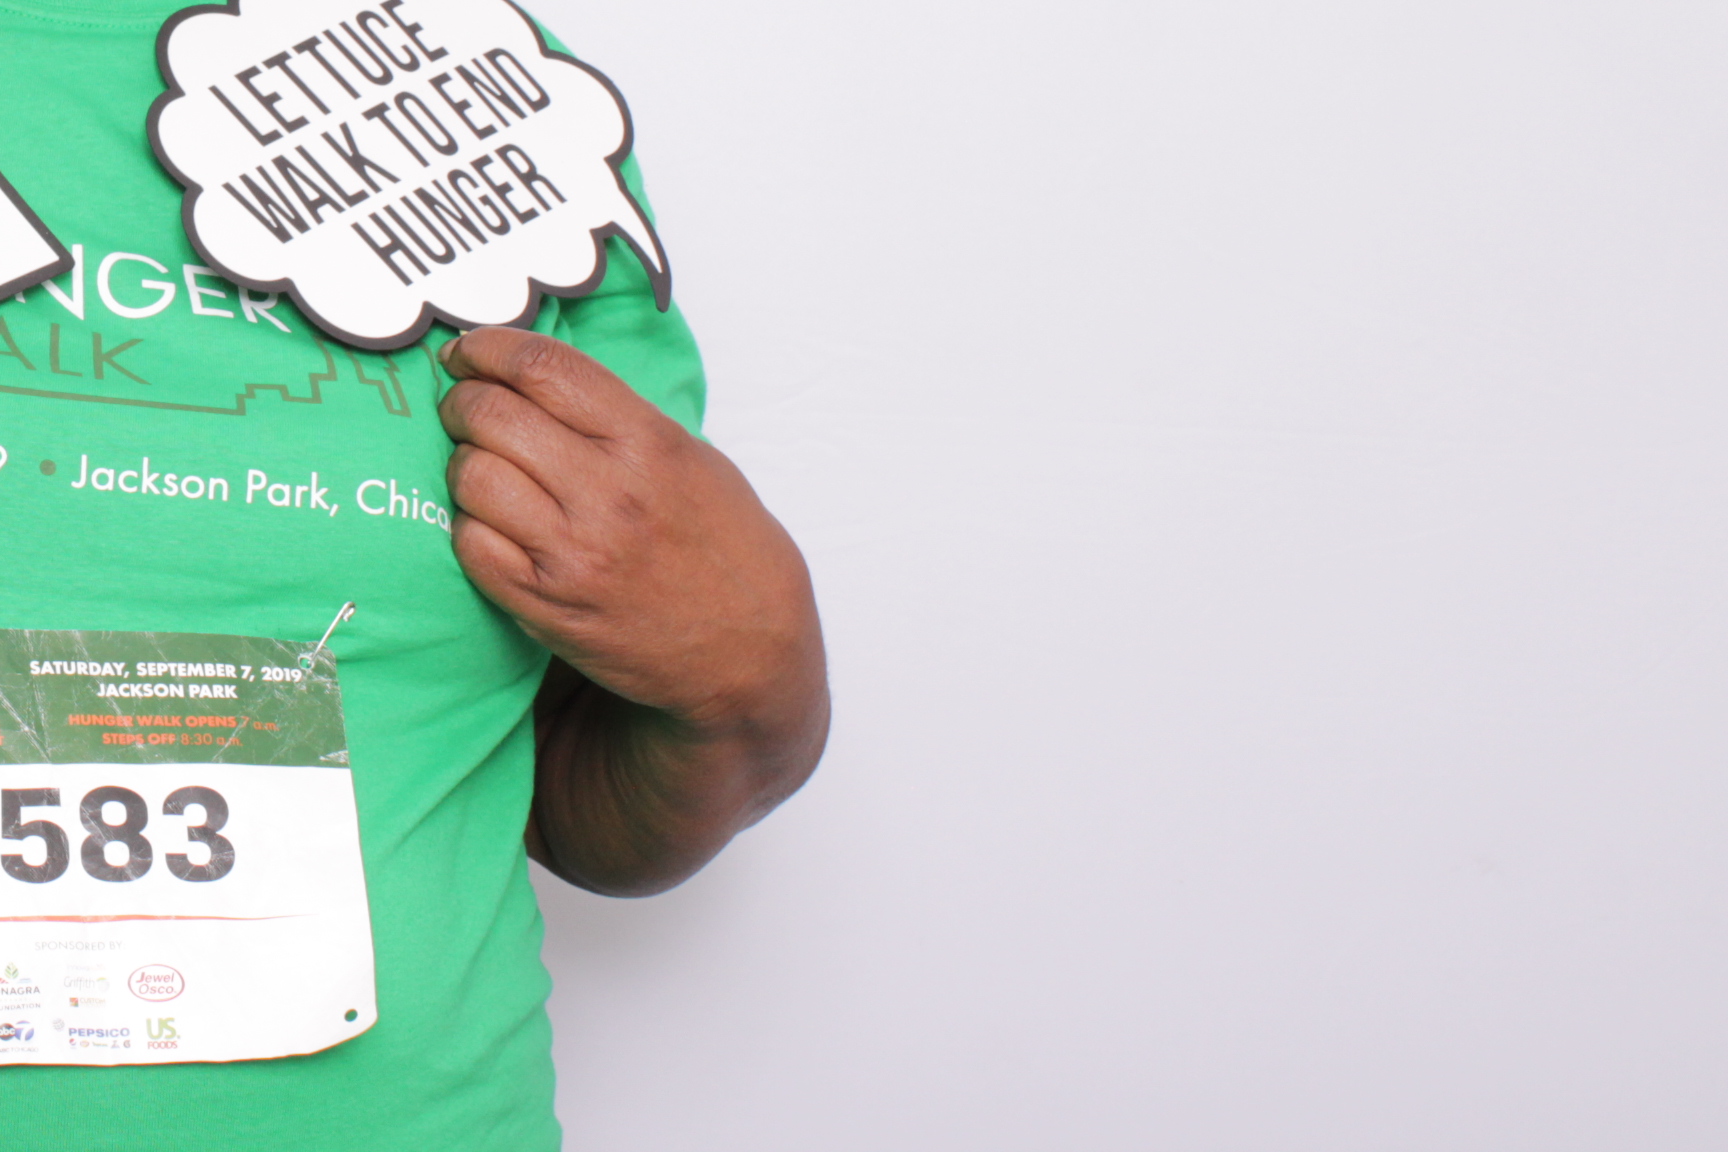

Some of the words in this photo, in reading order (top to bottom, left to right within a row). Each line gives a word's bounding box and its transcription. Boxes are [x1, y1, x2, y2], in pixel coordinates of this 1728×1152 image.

[222, 121, 401, 244] WALK
[361, 91, 459, 168] TO
[428, 48, 552, 141] END
[351, 144, 567, 286] HUNGER
[14, 244, 292, 333] NGER
[71, 454, 230, 502] Jackson
[245, 468, 340, 517] Park,
[356, 479, 452, 533] Chica
[29, 660, 130, 678] SATURDAY,
[136, 662, 237, 679] SEPTEMBER
[240, 664, 255, 682] 7,
[261, 665, 303, 683] 2019
[96, 682, 184, 698] JACKSON
[189, 684, 238, 699] PARK
[68, 714, 134, 728] HUNGER
[137, 715, 182, 728] WALK
[185, 715, 237, 728] OPENS
[102, 733, 145, 746] STEPS
[147, 733, 176, 746] OFF
[180, 733, 213, 747] 8:30
[35, 941, 106, 952] SPONSORED
[136, 971, 175, 984] Jewel
[68, 1026, 130, 1038] PEPSICO
[147, 1040, 178, 1050] FOODS
